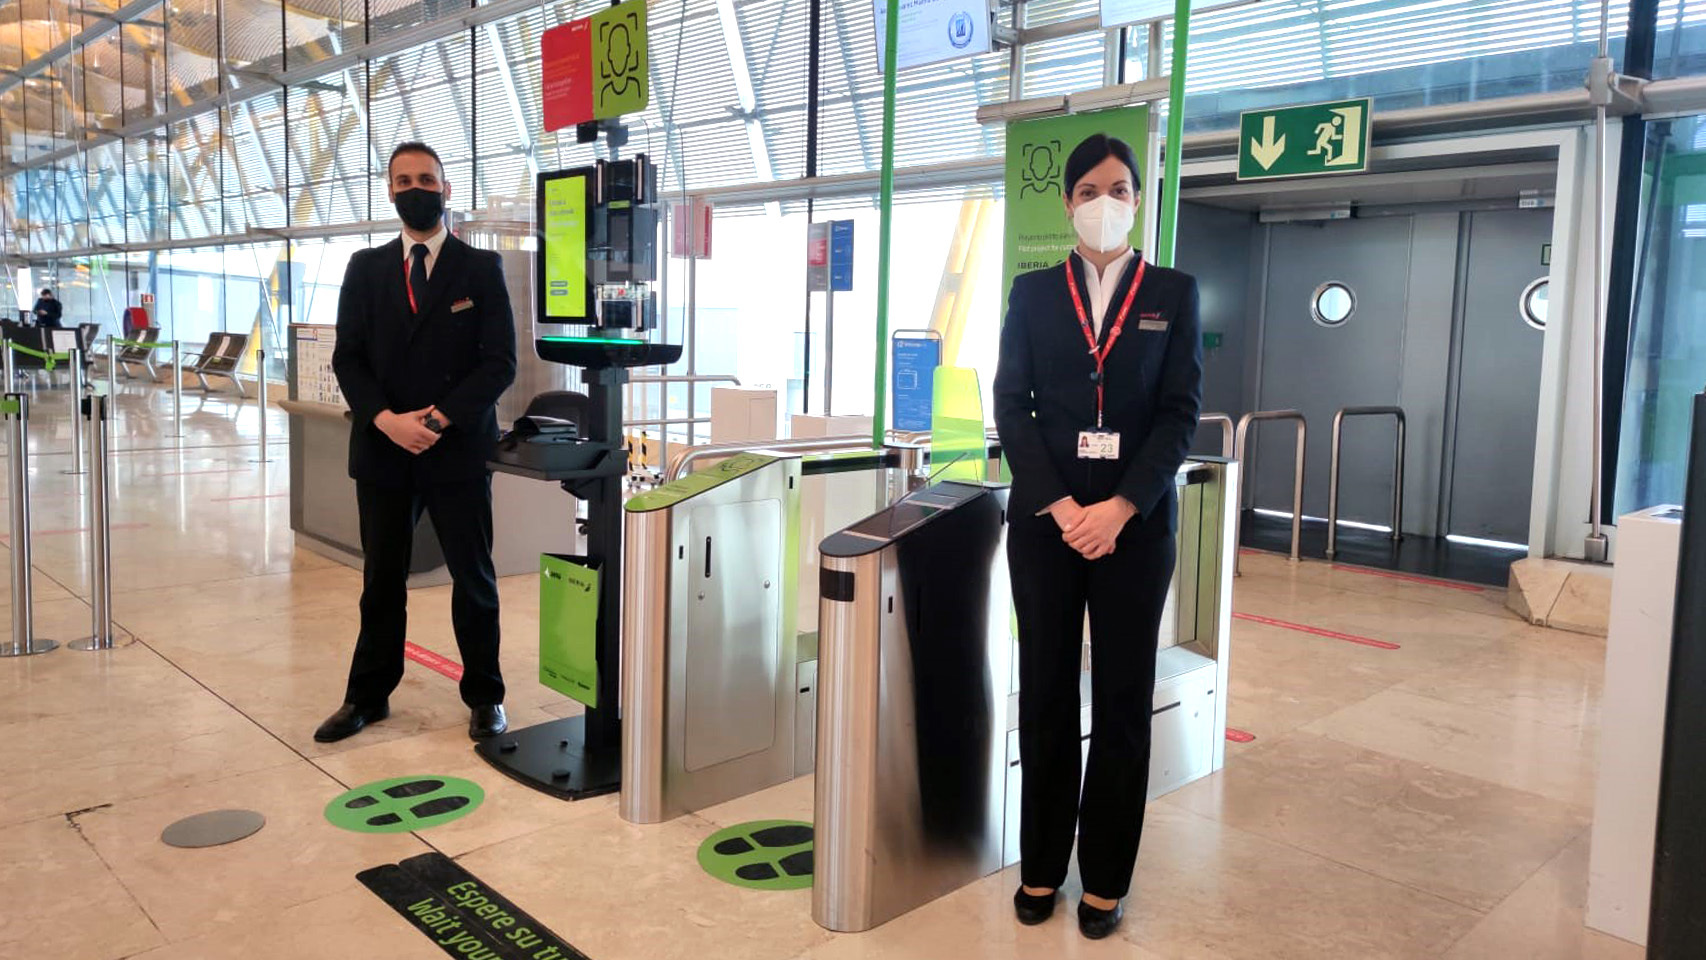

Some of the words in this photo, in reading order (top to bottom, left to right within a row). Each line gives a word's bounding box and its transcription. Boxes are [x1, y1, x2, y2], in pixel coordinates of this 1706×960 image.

[1018, 261, 1049, 269] IBERIA
[1100, 444, 1113, 453] 23
[407, 897, 462, 934] Wait
[438, 929, 504, 960] you
[447, 881, 516, 929] Espere
[505, 927, 543, 949] su
